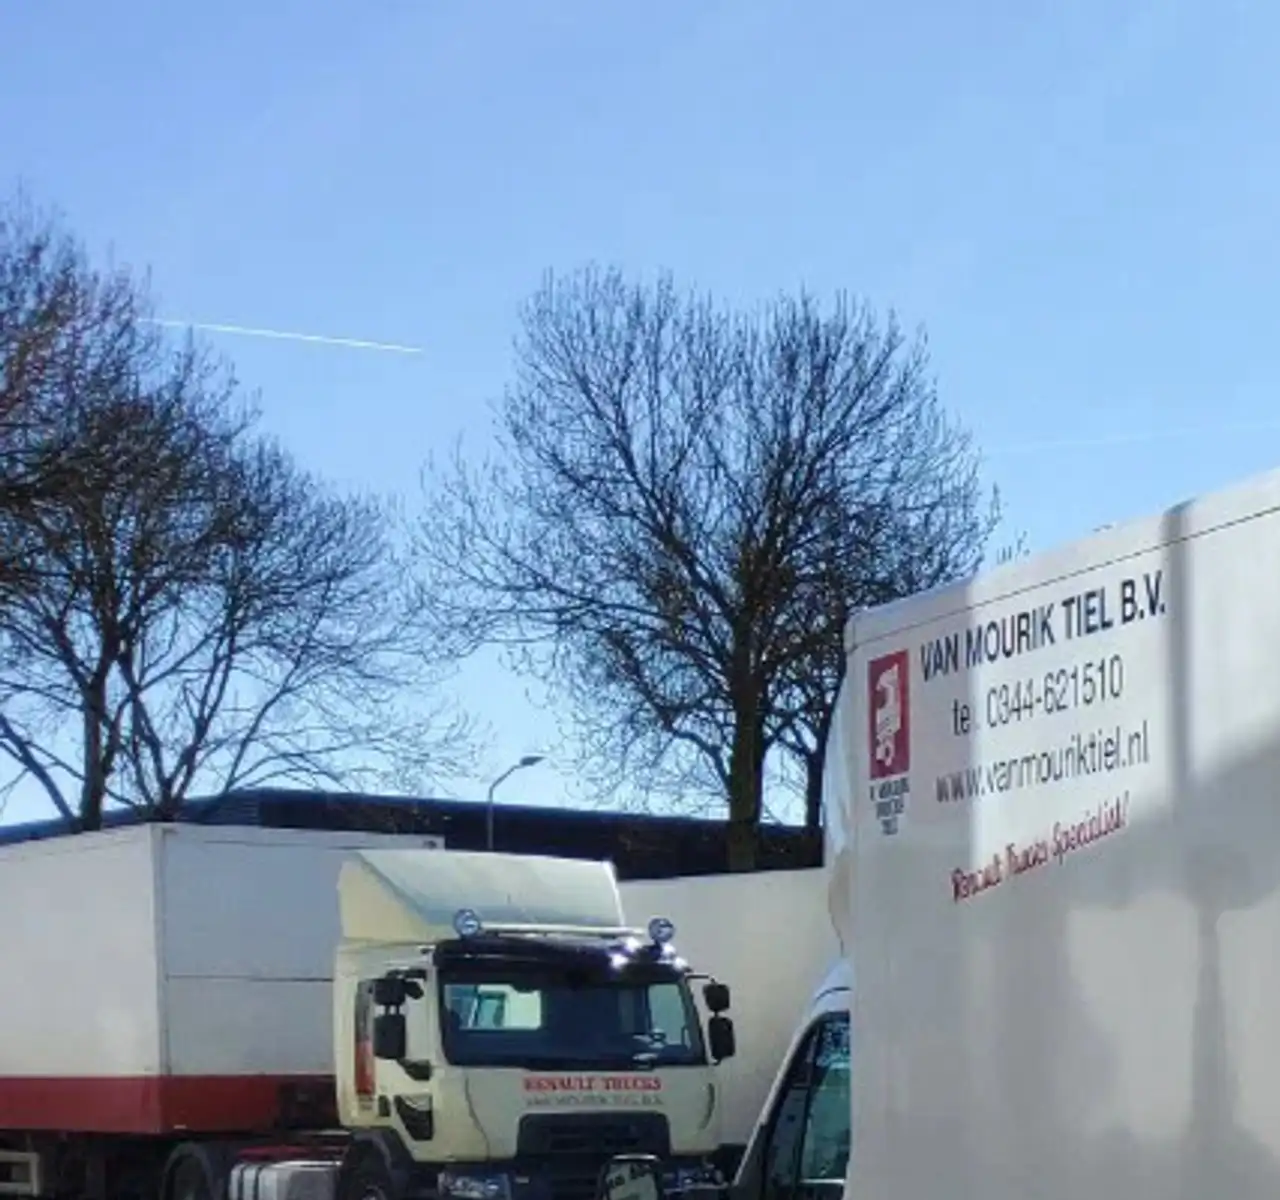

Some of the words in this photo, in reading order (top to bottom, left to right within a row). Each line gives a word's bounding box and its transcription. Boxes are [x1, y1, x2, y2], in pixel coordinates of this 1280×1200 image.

[920, 634, 959, 682] VAN
[965, 603, 1056, 669] MOURIK
[1062, 587, 1113, 640] TIEL
[1121, 570, 1167, 624] B.V.
[952, 699, 981, 736] te.
[986, 654, 1125, 729] 0344-621510
[935, 720, 1149, 803] www.vanmouriktiel.nl
